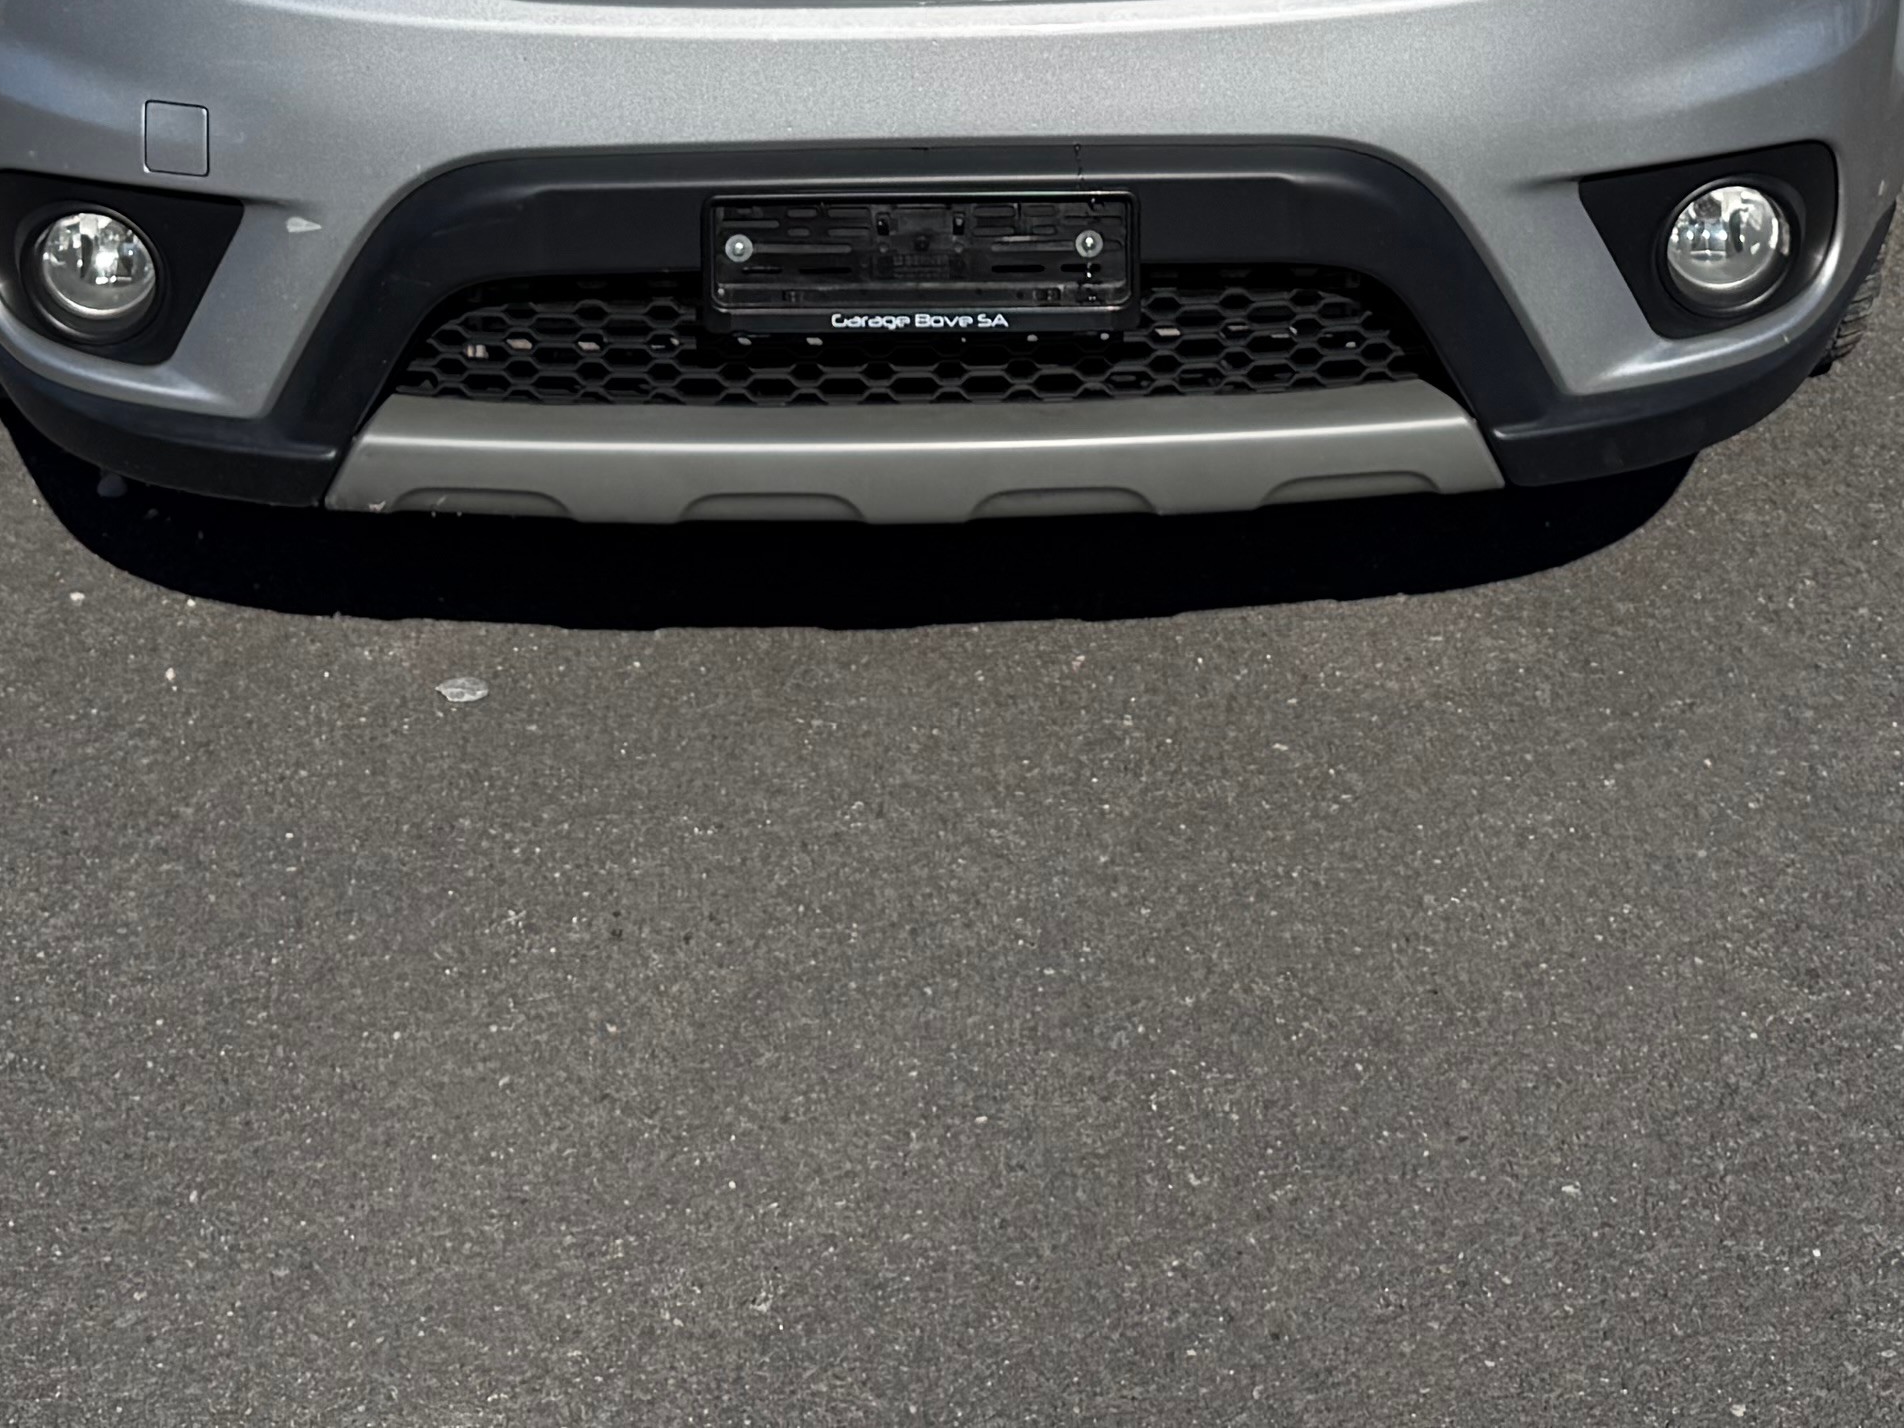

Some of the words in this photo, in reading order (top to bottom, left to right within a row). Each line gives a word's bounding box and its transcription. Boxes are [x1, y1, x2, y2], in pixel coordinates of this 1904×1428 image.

[831, 313, 911, 331] Garage
[914, 313, 974, 328] Bove
[977, 312, 1009, 328] SA
